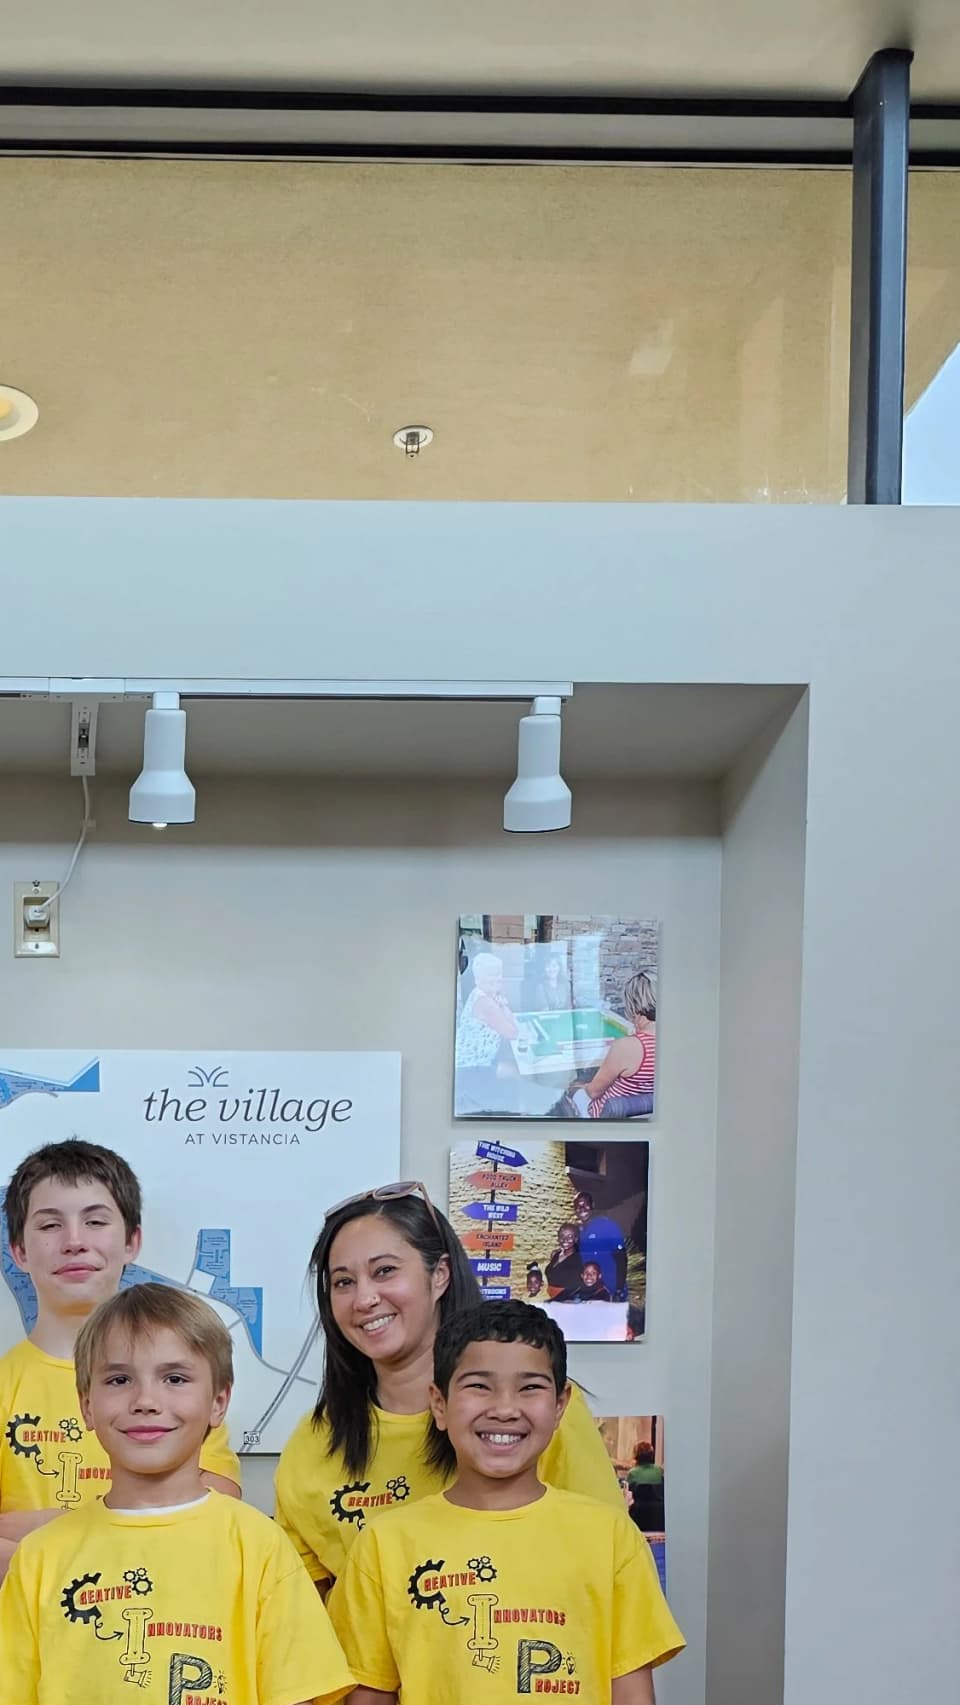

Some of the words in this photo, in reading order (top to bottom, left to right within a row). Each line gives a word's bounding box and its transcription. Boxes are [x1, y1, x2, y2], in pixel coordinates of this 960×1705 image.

[144, 1088, 207, 1122] the
[219, 1088, 353, 1132] village
[185, 1133, 205, 1144] AT
[212, 1133, 301, 1144] VISTANCIA
[477, 1262, 502, 1272] MUSIC
[245, 1435, 260, 1443] 303
